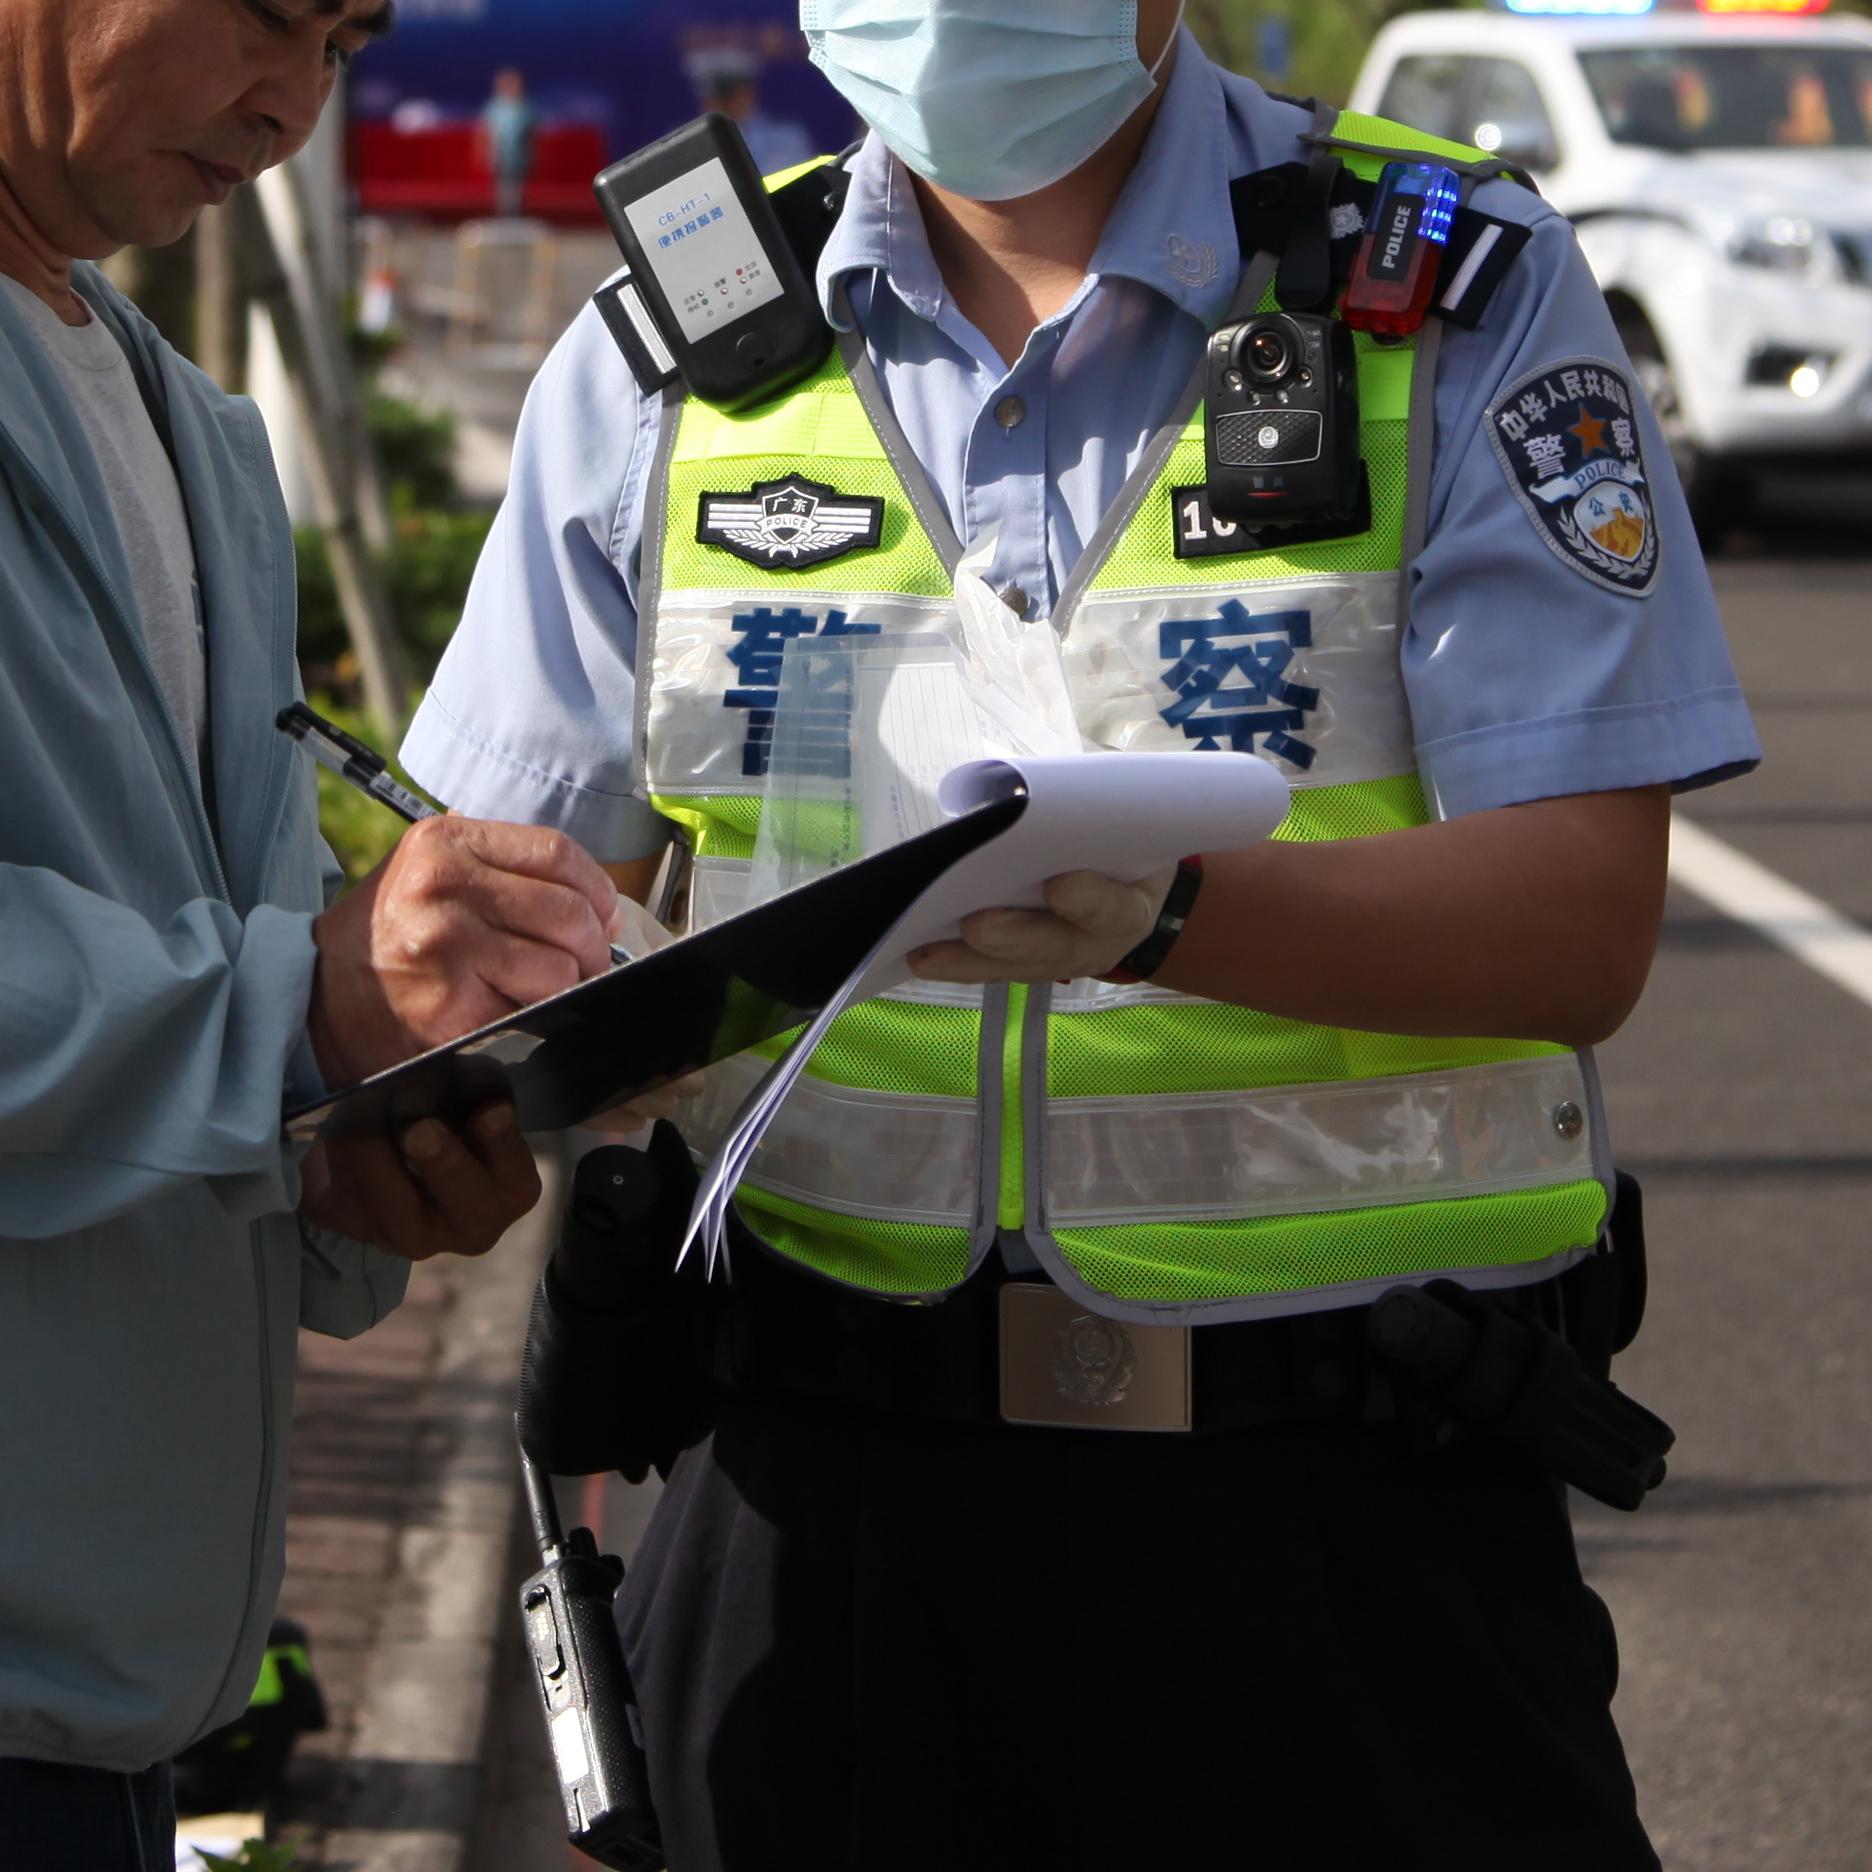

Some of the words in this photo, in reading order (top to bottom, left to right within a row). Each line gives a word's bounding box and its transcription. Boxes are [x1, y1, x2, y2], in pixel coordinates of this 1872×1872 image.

[658, 193, 711, 226] CB-HT-1
[1382, 205, 1412, 270] POLICE
[1499, 370, 1632, 442] 中华人民共和国
[1574, 461, 1627, 490] POLICE
[772, 496, 809, 513] 广东
[766, 518, 809, 528] POLICE
